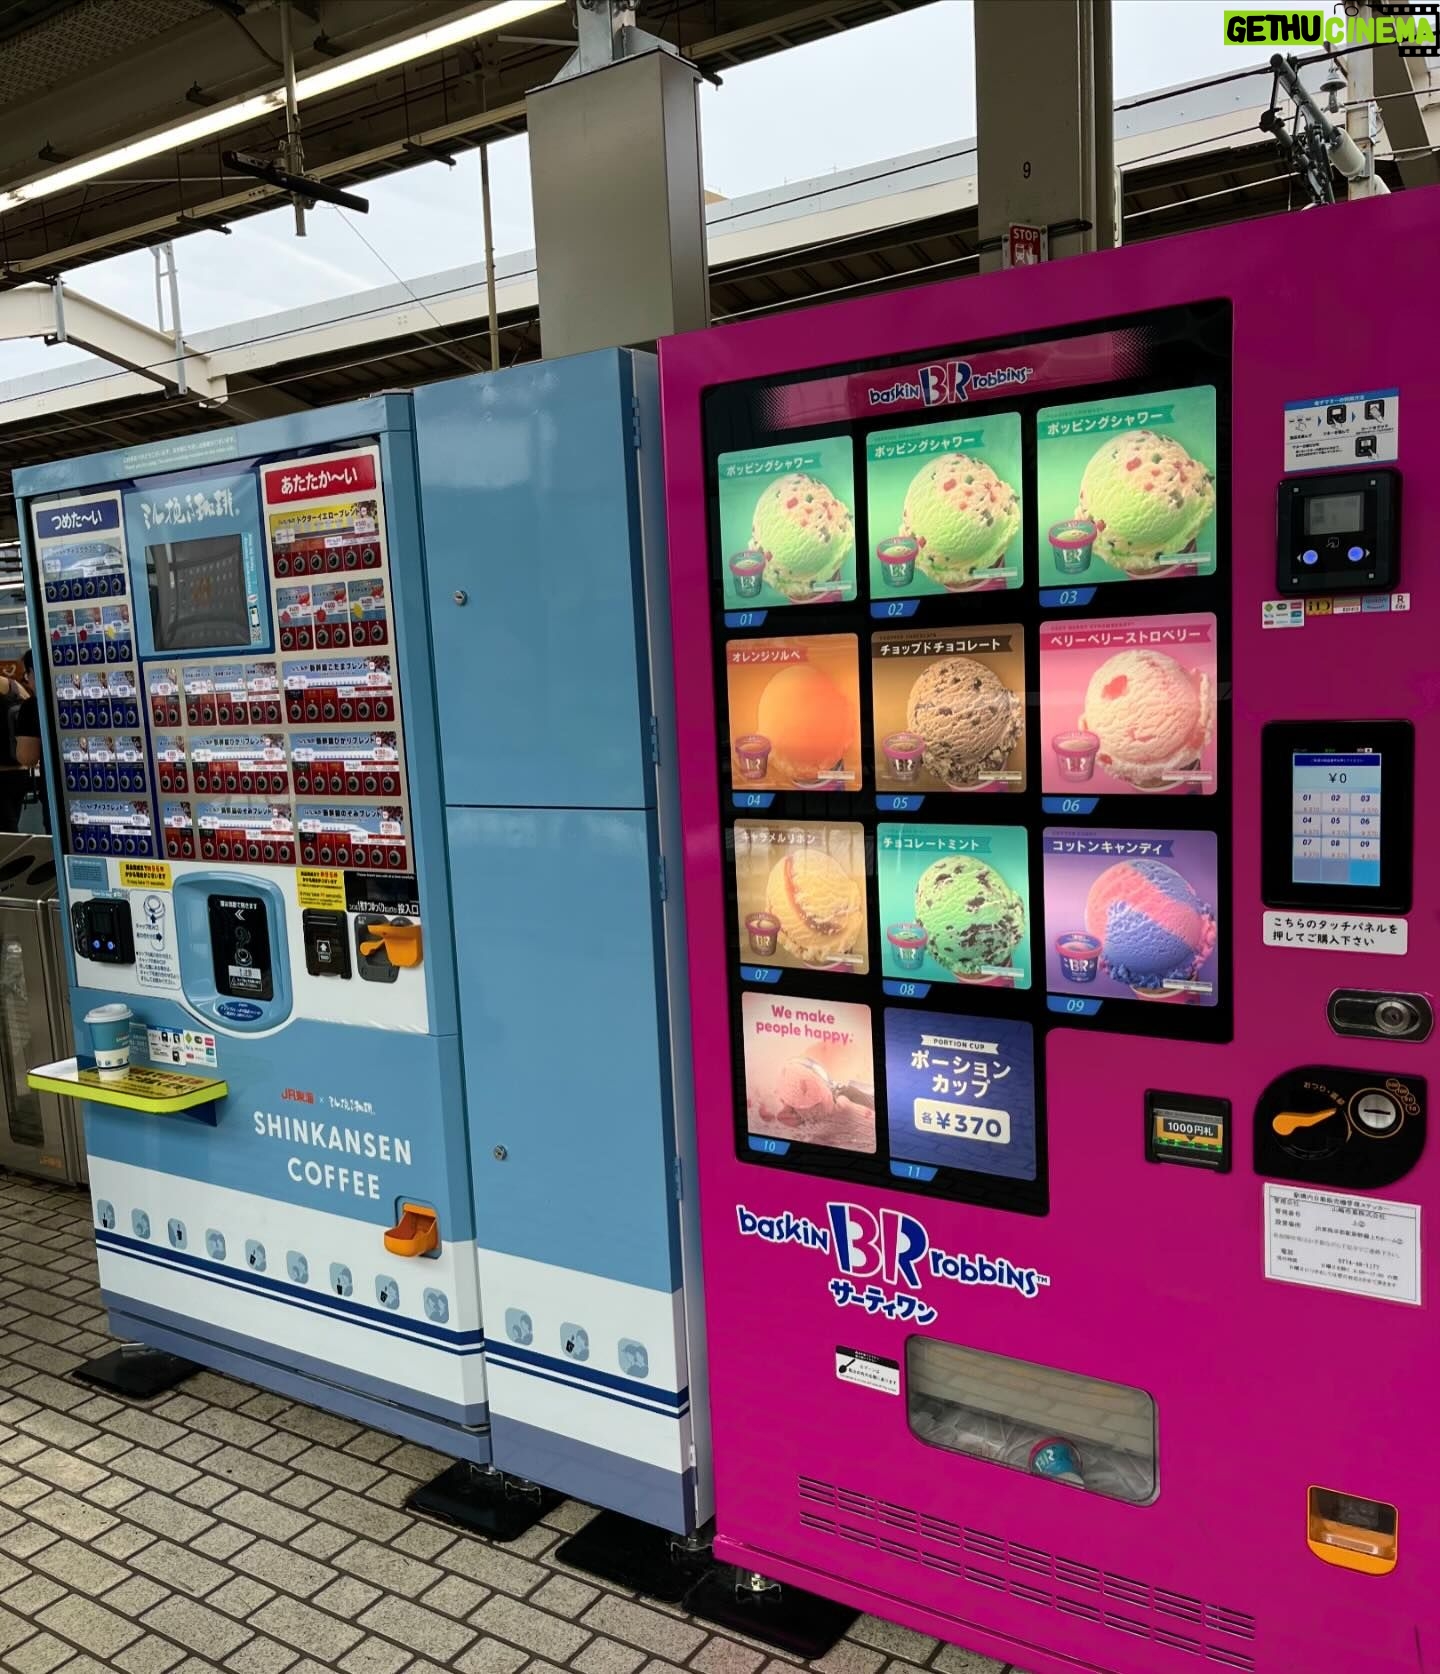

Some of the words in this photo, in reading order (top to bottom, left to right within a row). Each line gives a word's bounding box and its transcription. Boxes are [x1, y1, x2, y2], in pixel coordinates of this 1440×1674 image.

[1023, 161, 1032, 179] 9
[1013, 228, 1039, 242] STOP
[918, 361, 972, 406] BR
[1047, 411, 1163, 436] ポッピングシャワー
[874, 436, 975, 458] ポッピングシャワー
[726, 457, 814, 477] ポッピングシャワー
[1059, 590, 1078, 604] 03
[888, 602, 904, 616] 02
[739, 613, 753, 625] 01
[1051, 628, 1201, 647] ベリーベリーストロベリー
[880, 638, 1001, 656] チョップドチョコレート
[732, 649, 801, 663] オレンジソルベ
[747, 795, 761, 805] 04
[893, 796, 908, 809] 05
[1062, 799, 1080, 812] 06
[1331, 794, 1340, 802] 02
[883, 837, 979, 851] チョコレートミント
[1053, 840, 1163, 855] コットンキャンディ
[1273, 917, 1398, 935] こちらのタッチパネルを
[1273, 931, 1375, 946] 押してご購入下さい
[754, 969, 769, 980] 07
[900, 983, 915, 995] 08
[1067, 999, 1085, 1012] 09
[771, 1004, 792, 1019] We
[795, 1009, 835, 1024] make
[755, 1021, 801, 1037] people
[933, 1037, 967, 1048] PORTION
[969, 1042, 985, 1050] CUP
[911, 1050, 1012, 1079] ポーション
[932, 1073, 991, 1098] カップ
[1168, 1121, 1214, 1136] 1000円札
[253, 1111, 412, 1166] SHINKANSEN
[763, 1140, 776, 1152] 10
[287, 1157, 381, 1200] COFFEE
[907, 1165, 921, 1177] 11
[826, 1202, 930, 1289] BR
[828, 1279, 938, 1326] サーティワン
